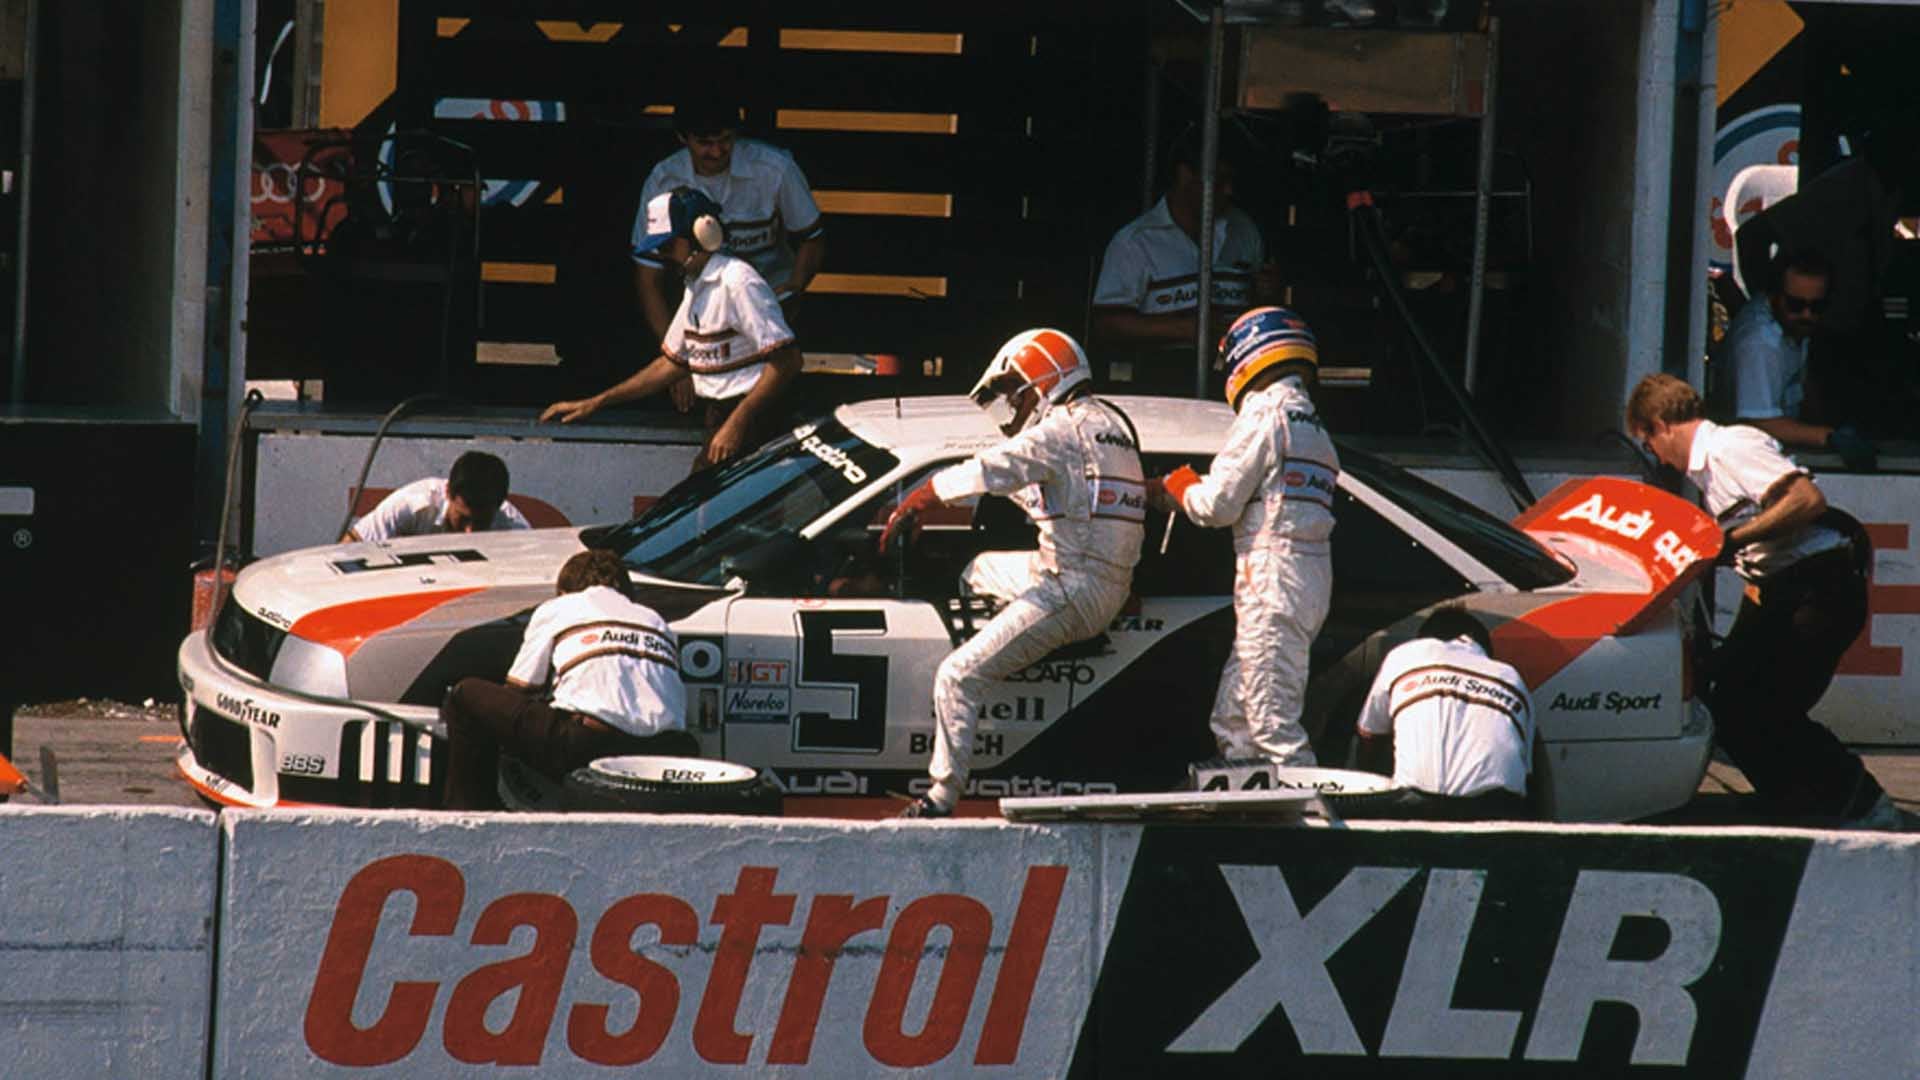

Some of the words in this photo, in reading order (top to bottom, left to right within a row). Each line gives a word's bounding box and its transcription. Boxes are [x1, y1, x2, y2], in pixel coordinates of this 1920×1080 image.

[801, 434, 867, 485] quattro
[1557, 493, 1654, 540] Audi
[600, 629, 640, 645] Audi
[793, 609, 890, 753] 5
[1420, 673, 1460, 687] Audi
[1463, 679, 1513, 708] Sport
[216, 691, 281, 729] GOODYEAR
[728, 690, 786, 712] Norelco
[1550, 692, 1600, 712] Audi
[1602, 691, 1662, 714] Sport
[758, 767, 869, 794] Audi
[303, 853, 1069, 1068] Castrol
[1164, 864, 1722, 1067] XLR
